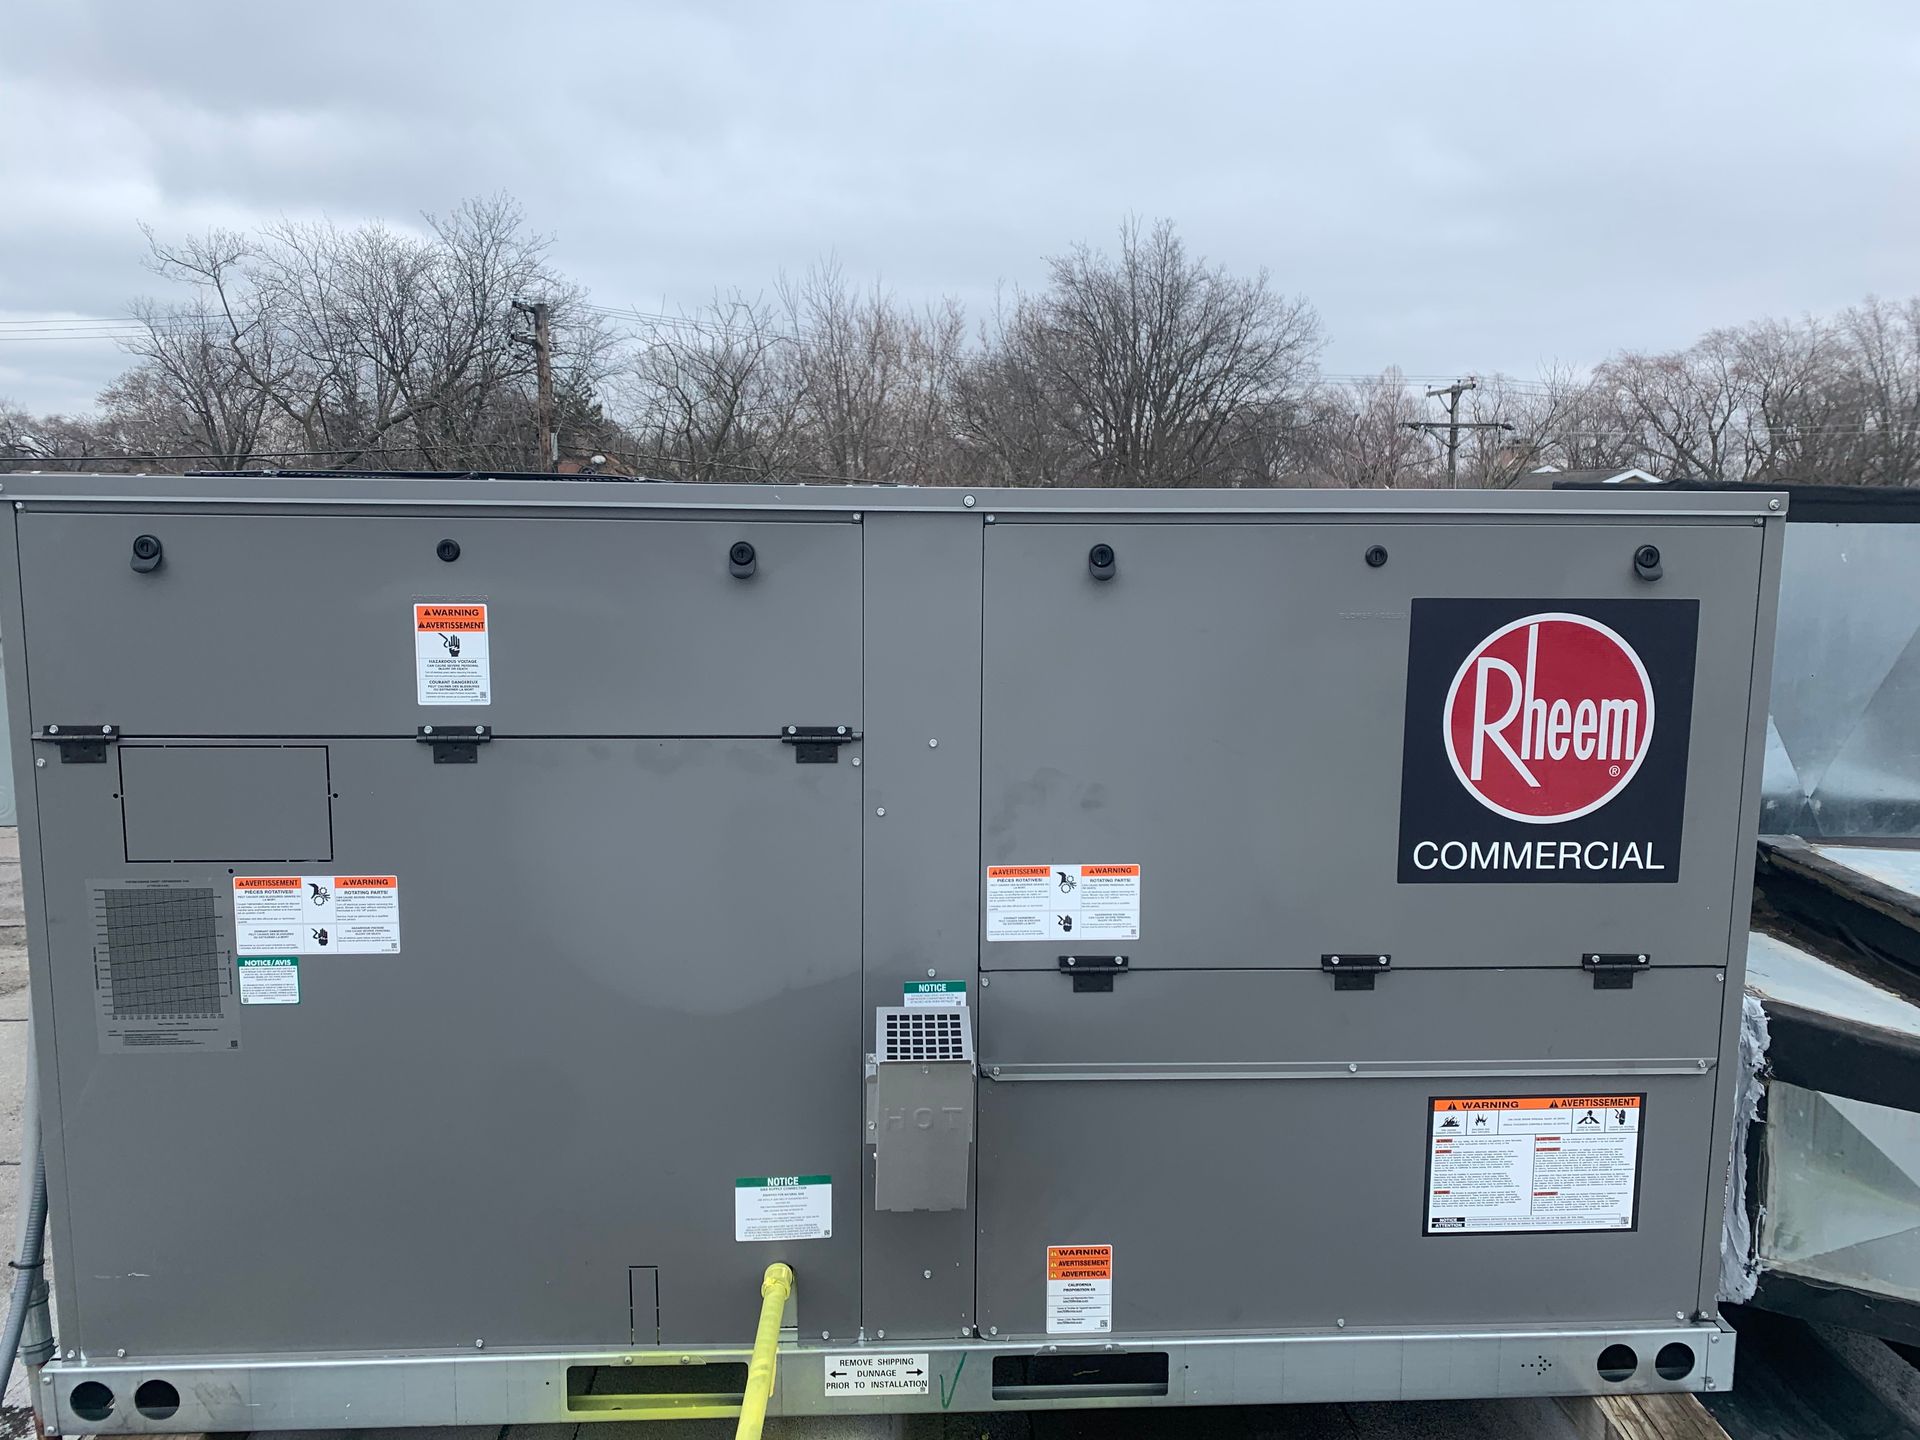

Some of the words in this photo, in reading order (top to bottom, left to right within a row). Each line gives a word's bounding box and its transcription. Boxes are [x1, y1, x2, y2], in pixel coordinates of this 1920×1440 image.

[1471, 624, 1639, 787] Rheem
[1413, 841, 1665, 870] COMMERCIAL
[918, 984, 947, 992] NOTICE
[1462, 1101, 1519, 1109] WARNING
[1561, 1098, 1635, 1107] AVERTISSEMENT
[884, 1107, 963, 1130] HOT
[767, 1177, 799, 1186] NOTICE
[877, 1358, 914, 1366] SHIPPING
[871, 1380, 928, 1388] INSTALLATION
